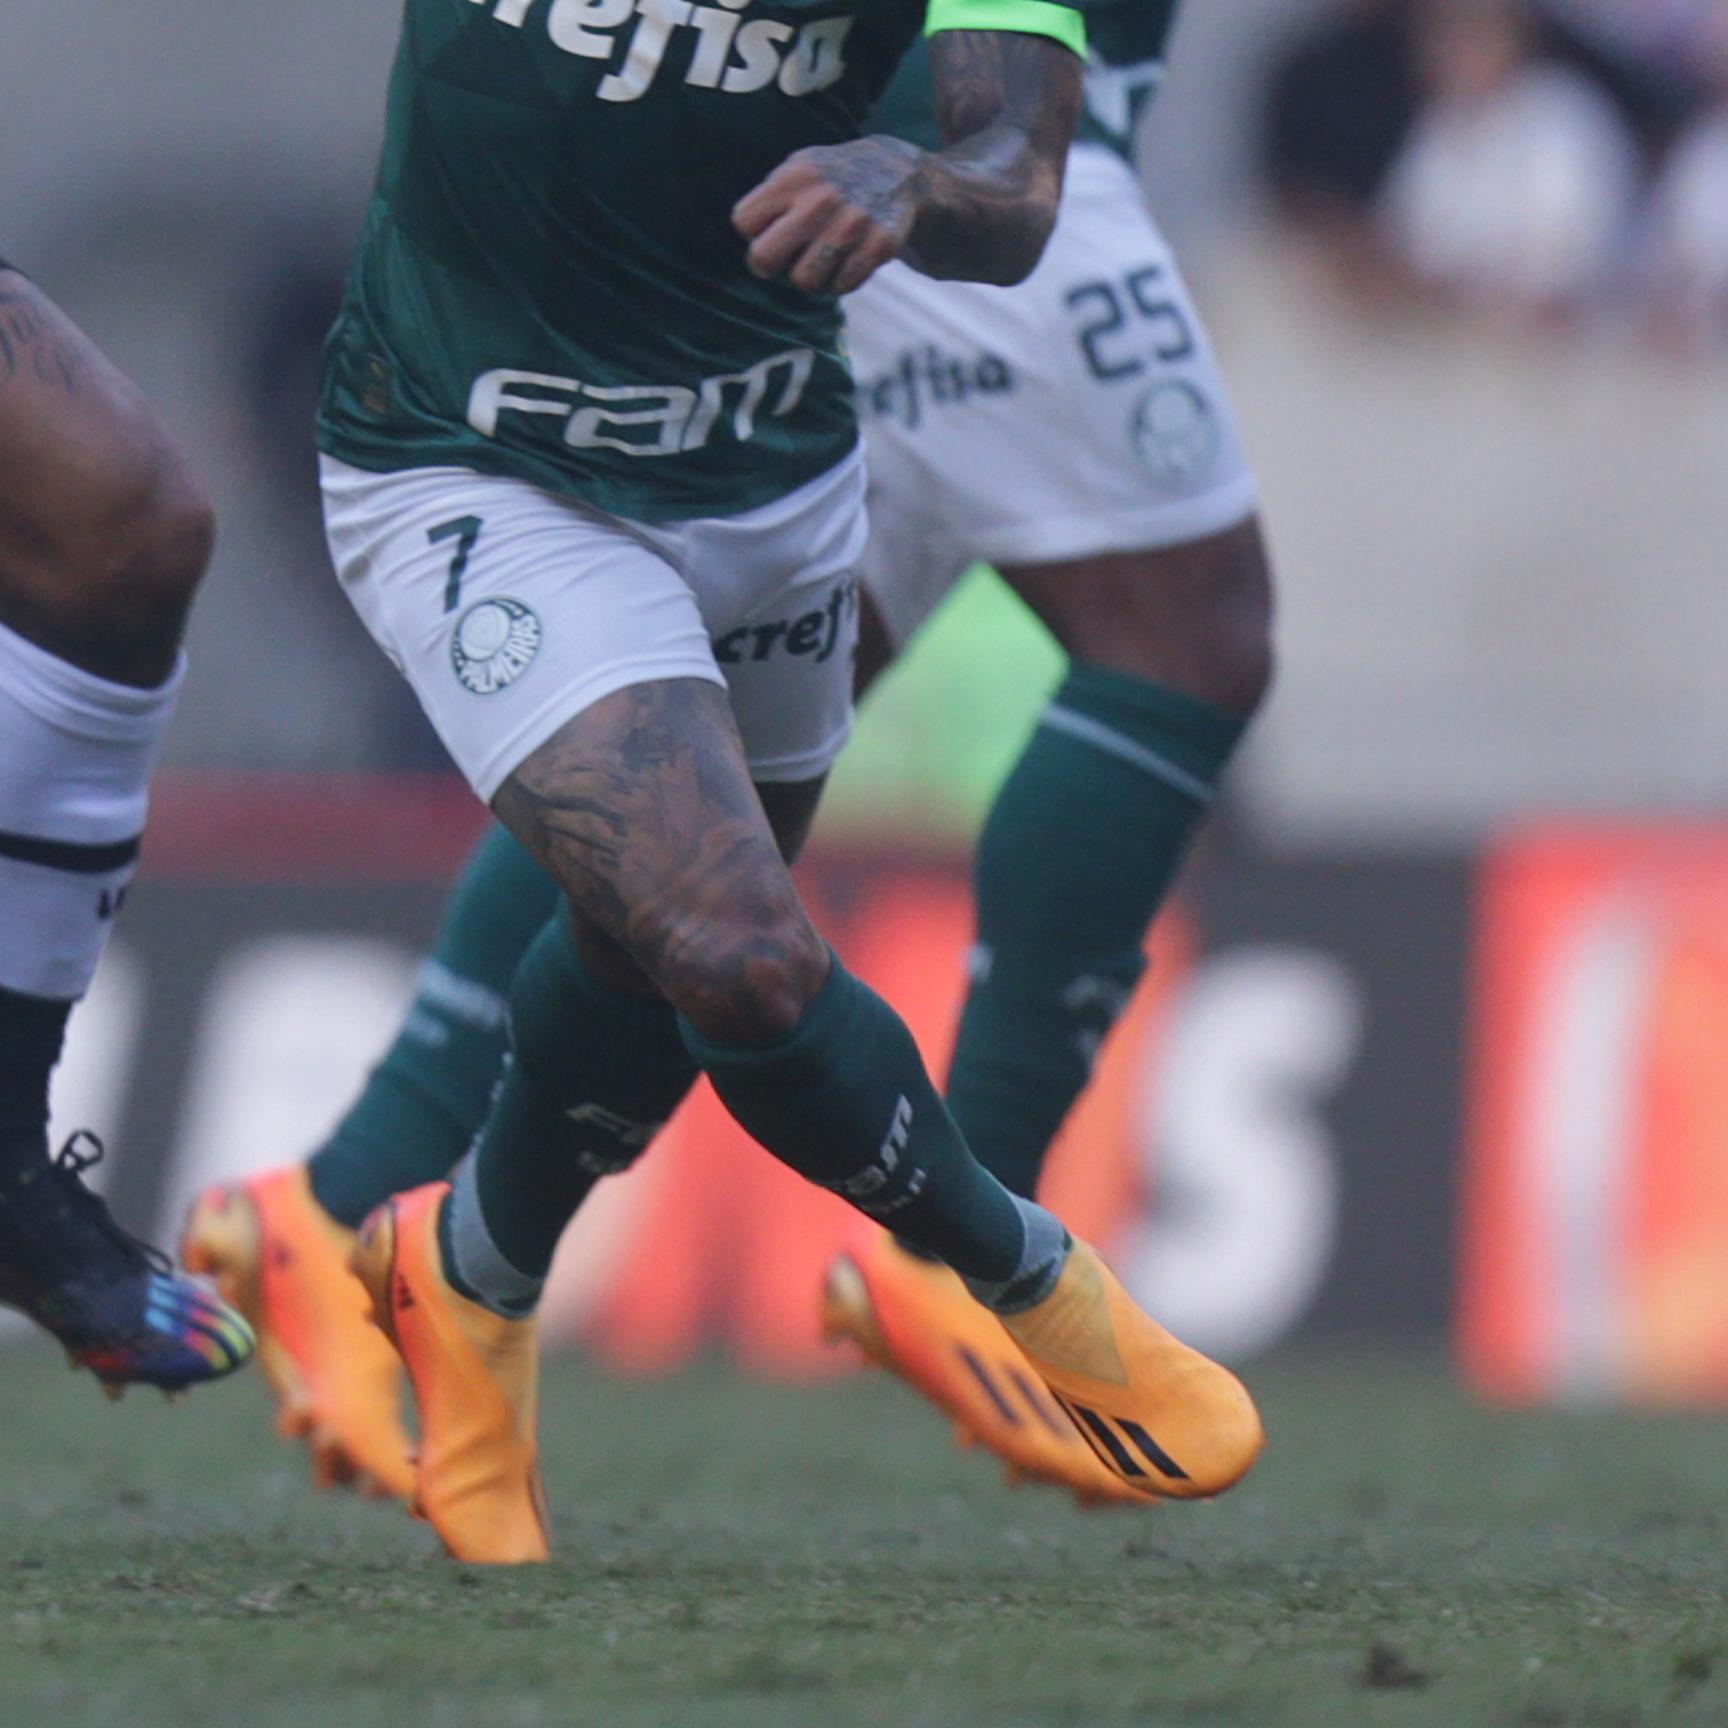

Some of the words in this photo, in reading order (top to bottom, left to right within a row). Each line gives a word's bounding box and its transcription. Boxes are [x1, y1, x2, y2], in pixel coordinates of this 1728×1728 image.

[1064, 266, 1196, 388] 25
[467, 349, 815, 457] Fam
[426, 514, 483, 614] 7
